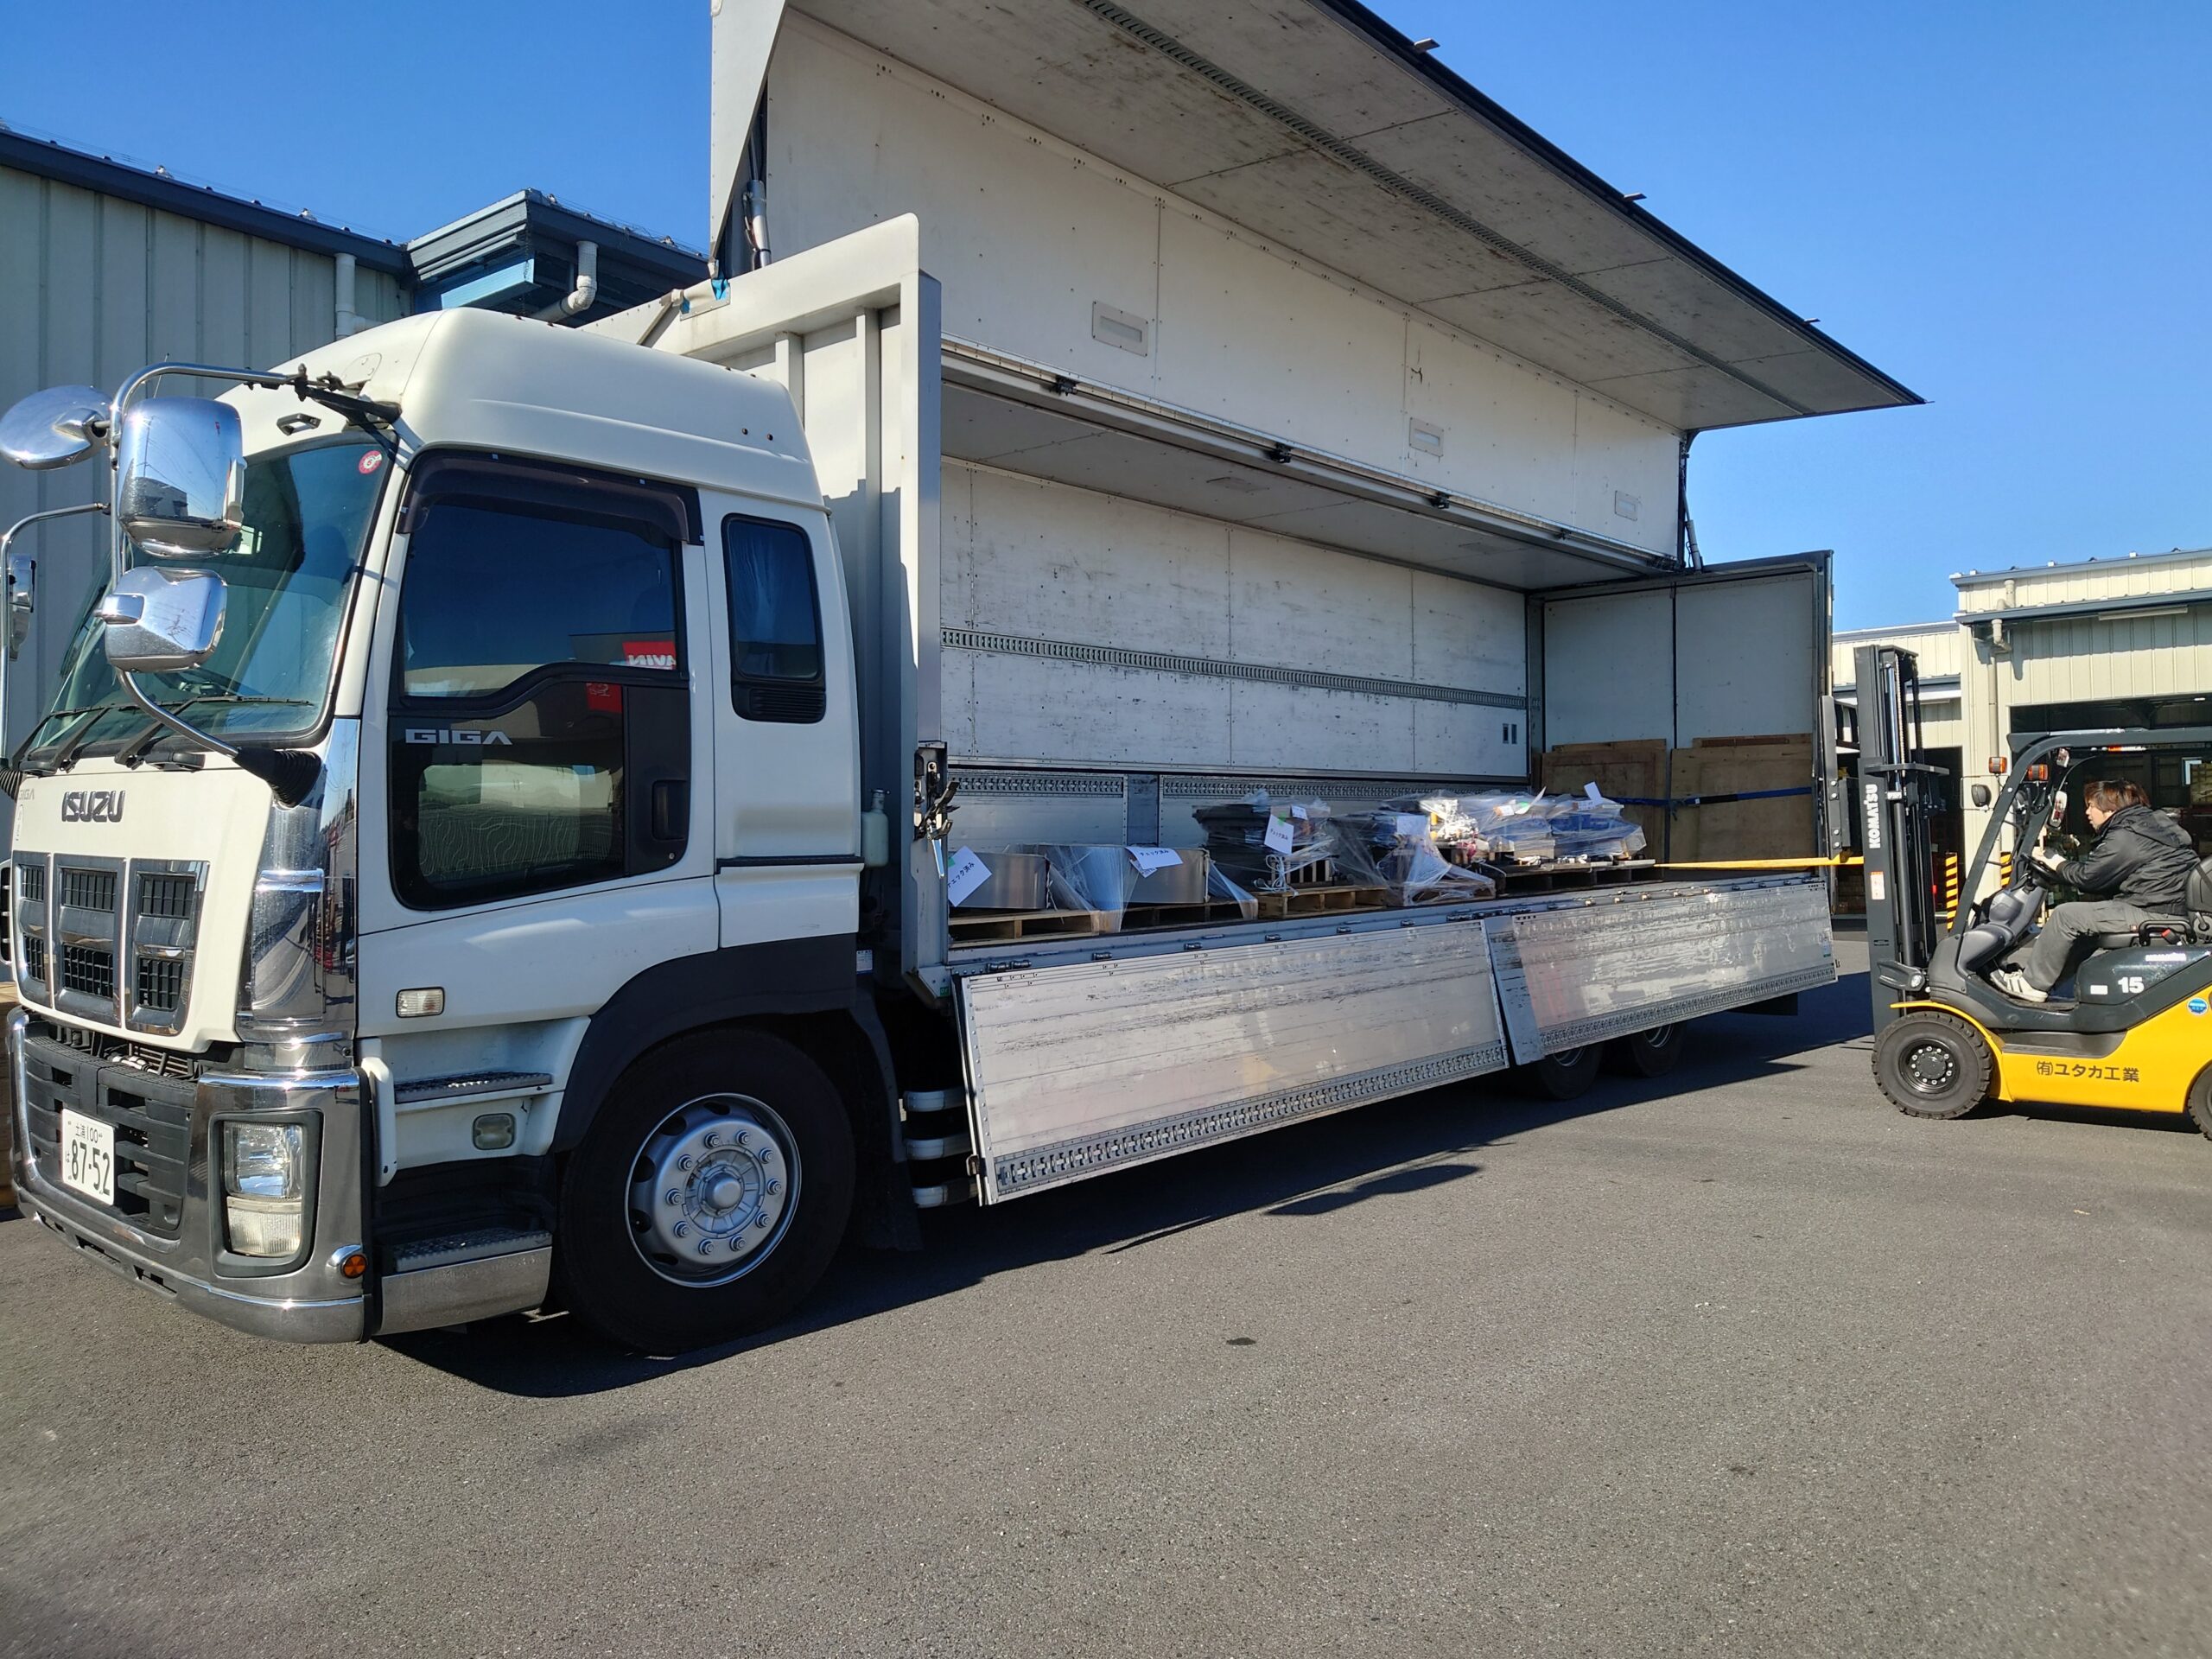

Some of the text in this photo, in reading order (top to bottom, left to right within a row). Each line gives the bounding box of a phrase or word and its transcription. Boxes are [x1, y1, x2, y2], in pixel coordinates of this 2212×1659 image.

[405, 728, 512, 745] GIGA
[61, 791, 125, 823] ISUZU
[1864, 784, 1881, 849] KOMATSU
[2118, 976, 2145, 994] 15
[86, 1126, 99, 1144] 100
[71, 1139, 110, 1196] 87-52
